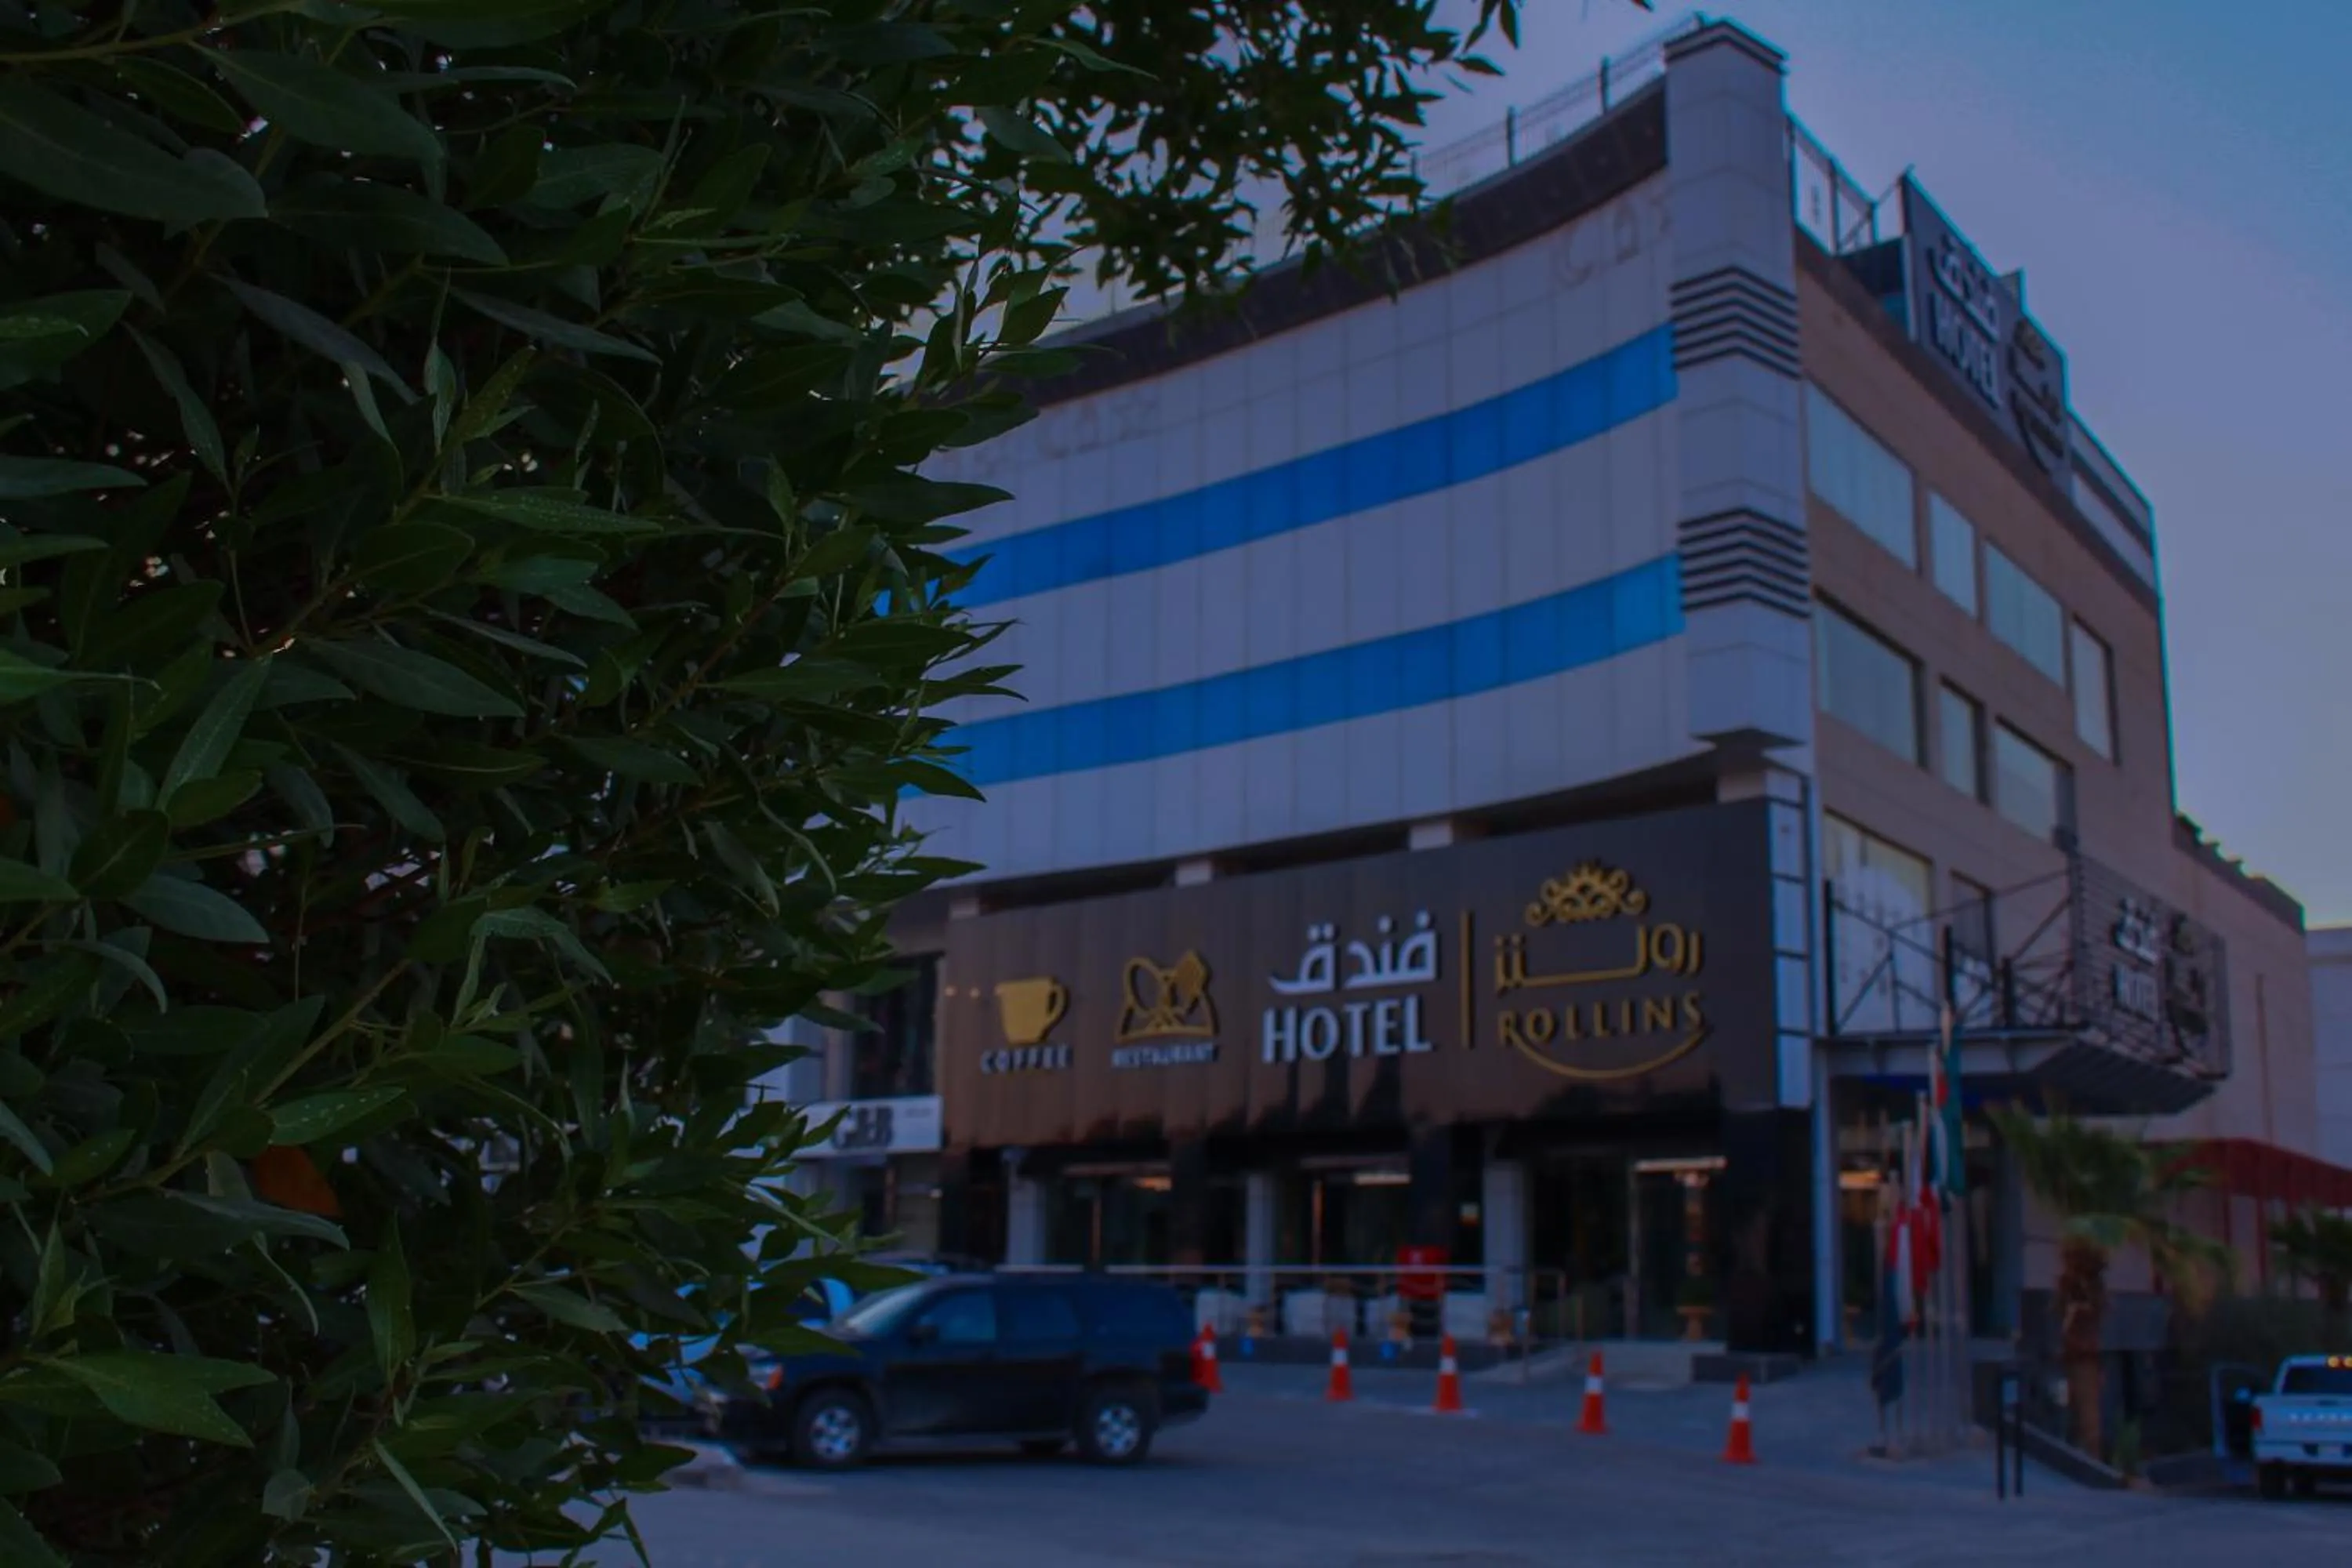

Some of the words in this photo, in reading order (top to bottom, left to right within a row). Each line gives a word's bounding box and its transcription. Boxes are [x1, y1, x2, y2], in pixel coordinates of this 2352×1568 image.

[1268, 909, 1438, 995] فندق
[1261, 995, 1433, 1063] HOTEL
[1497, 989, 1706, 1047] ROLLINS
[980, 1043, 1070, 1075] COFFEE
